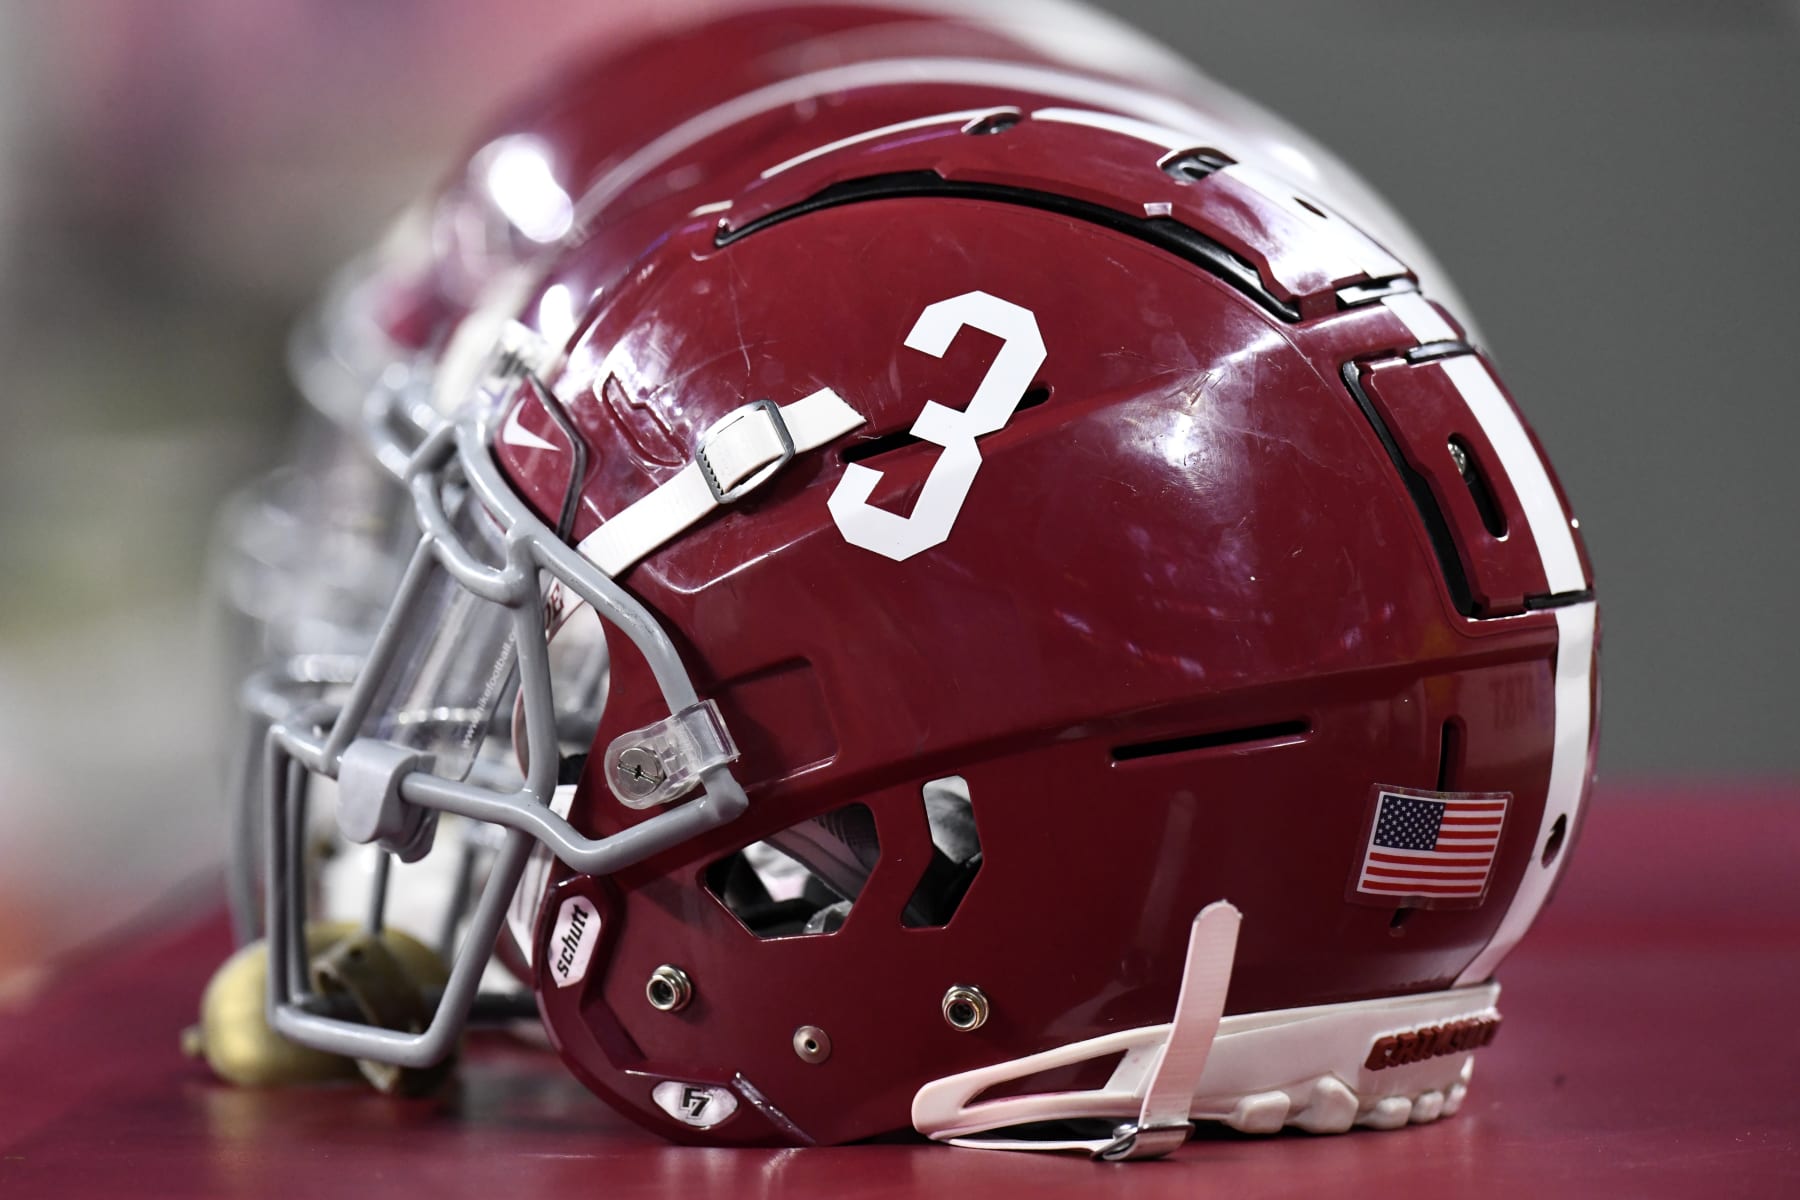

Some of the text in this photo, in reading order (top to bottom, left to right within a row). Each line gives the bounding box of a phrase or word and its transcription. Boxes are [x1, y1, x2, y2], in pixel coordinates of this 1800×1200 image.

[827, 290, 1047, 562] 3
[461, 630, 516, 748] www.nikefootball.c
[557, 903, 589, 978] schutt
[681, 1086, 712, 1118] F7
